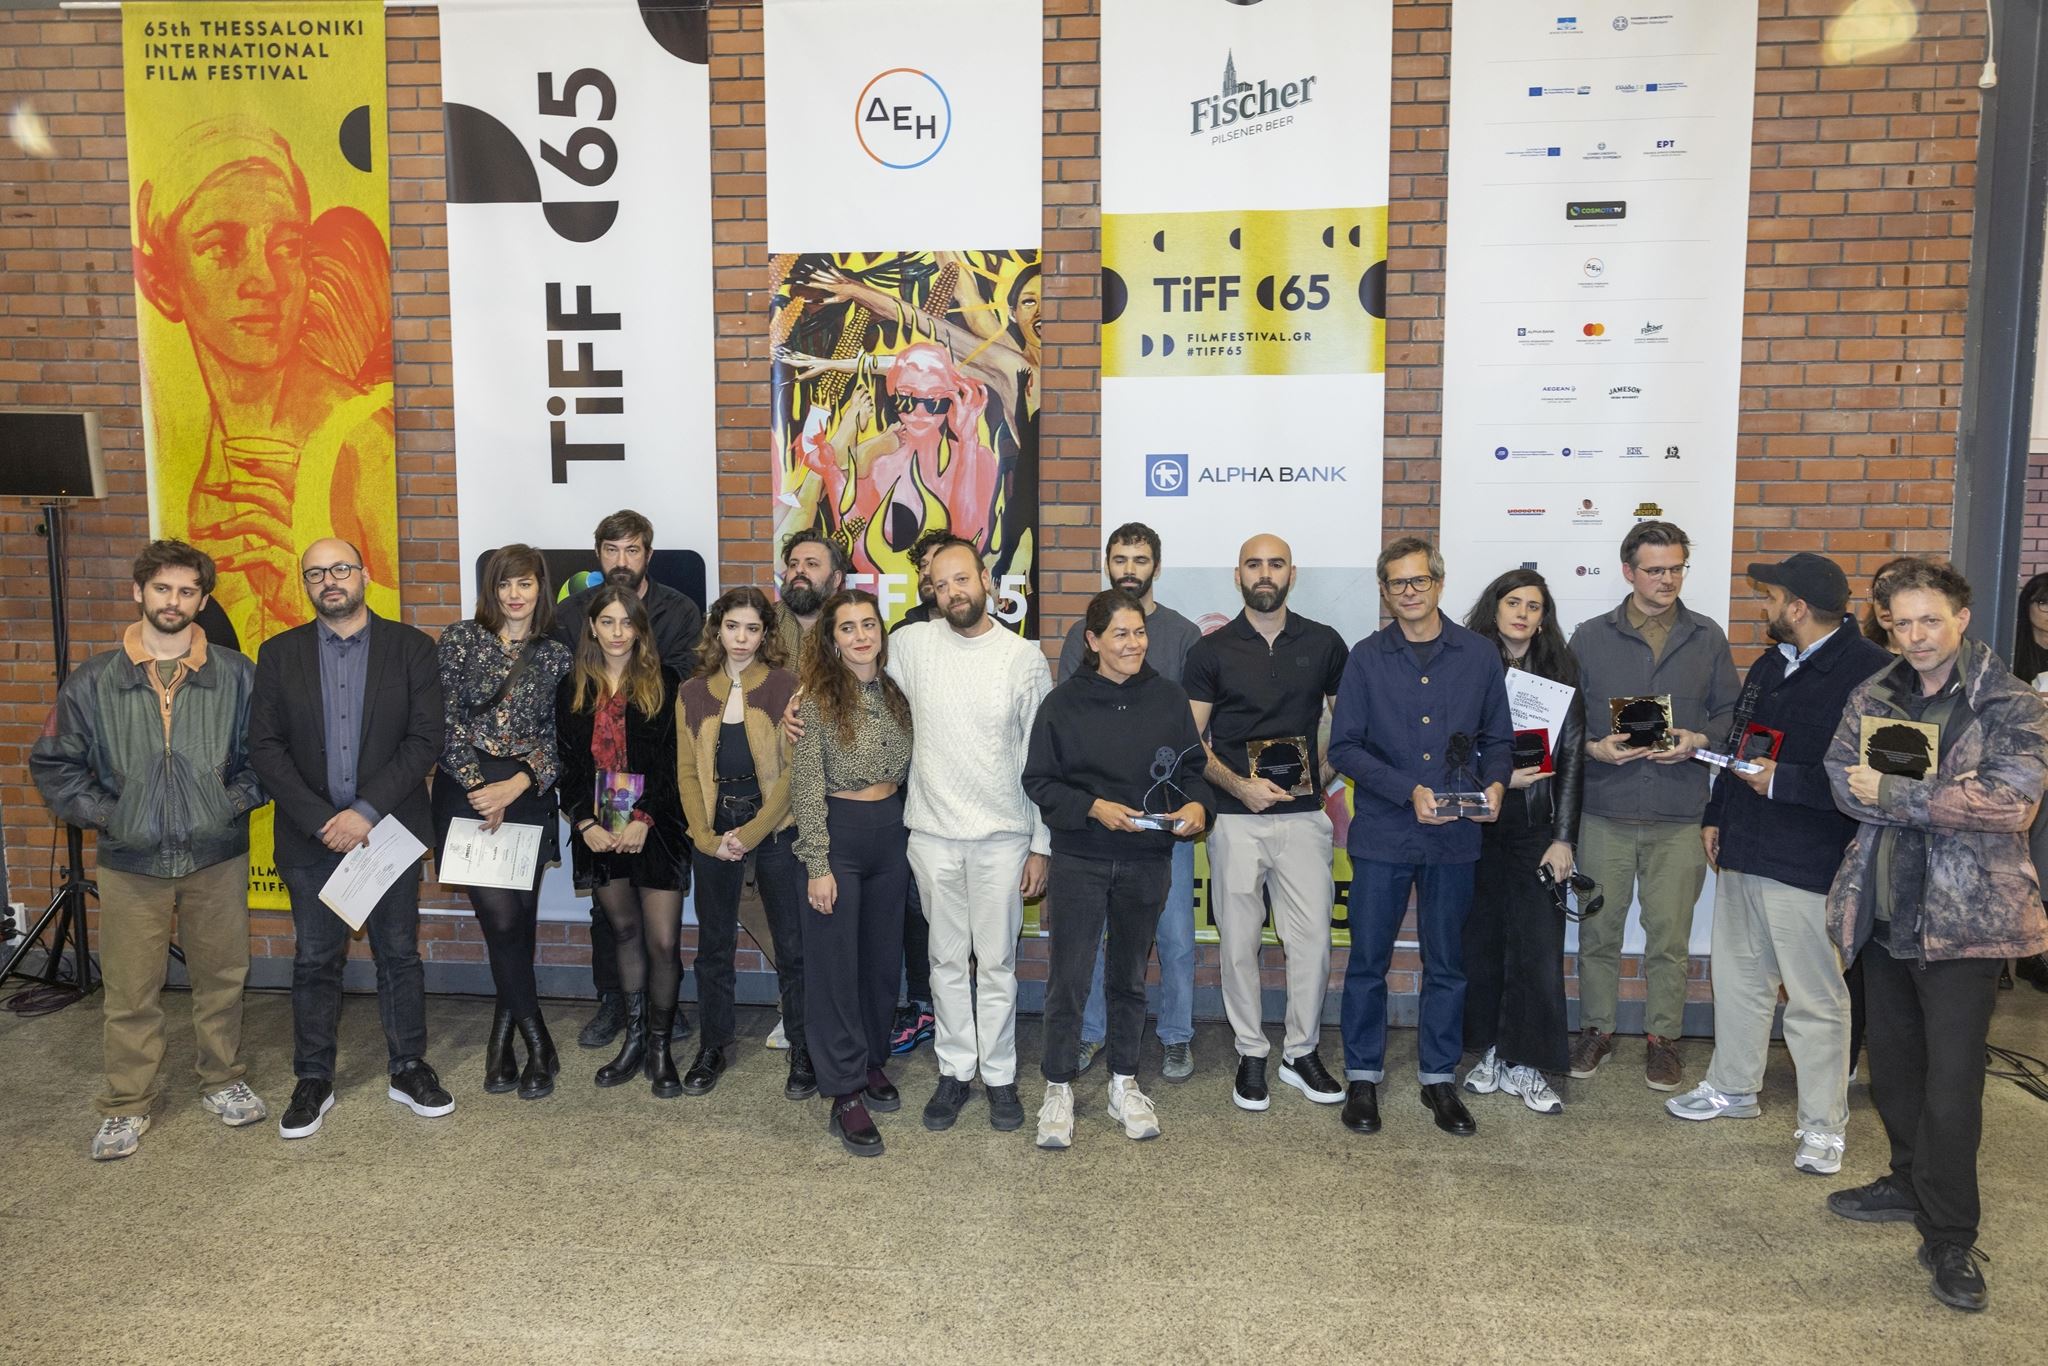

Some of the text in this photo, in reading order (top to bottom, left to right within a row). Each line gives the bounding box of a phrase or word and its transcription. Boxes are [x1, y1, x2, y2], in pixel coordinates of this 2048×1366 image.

[144, 20, 363, 37] 65th THESSALONIKI
[145, 42, 329, 59] INTERNATIONAL
[146, 64, 308, 81] FILM FESTIVAL
[1190, 75, 1317, 136] Fischer
[1211, 115, 1295, 146] PILSENER BEER
[537, 67, 626, 484] TiFF 65
[1153, 274, 1330, 313] TiFF 65
[1187, 332, 1312, 344] FILMFESTIVAL.GR
[1187, 346, 1243, 357] #TIFF65
[1608, 386, 1641, 395] JAMESON
[1198, 466, 1346, 483] ALPHA BANK
[1588, 567, 1600, 575] LG
